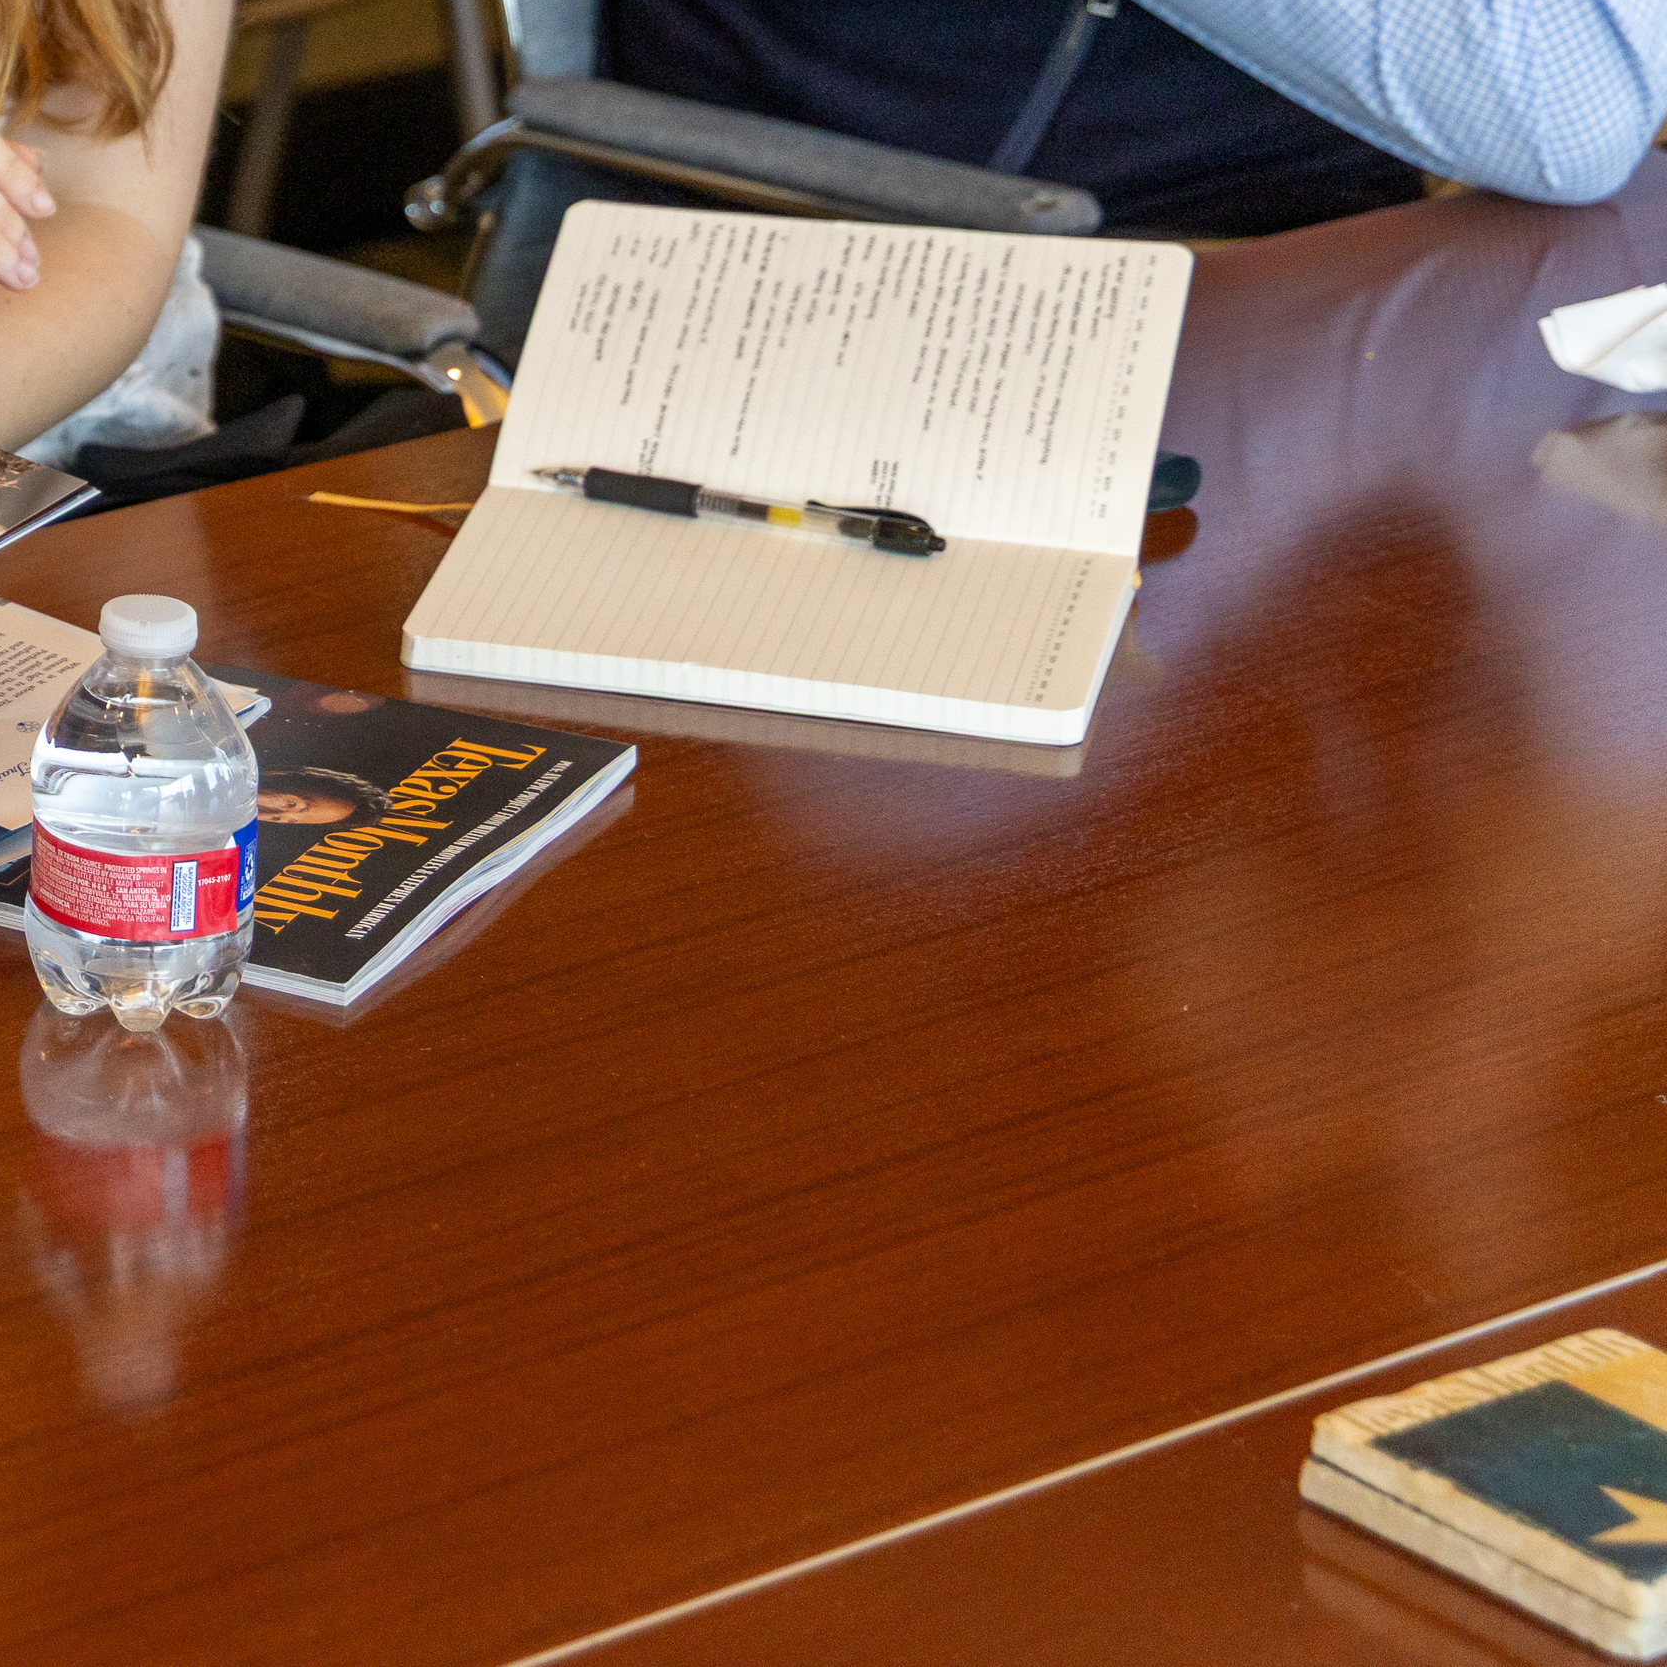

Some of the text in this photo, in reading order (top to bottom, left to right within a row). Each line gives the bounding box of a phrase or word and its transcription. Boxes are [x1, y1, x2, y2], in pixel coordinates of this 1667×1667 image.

[502, 791, 540, 814] PROJECT
[453, 824, 497, 847] WILLIAM
[104, 863, 136, 874] PROTECTED
[101, 870, 108, 878] BY
[109, 872, 141, 881] ADVANCED
[197, 873, 232, 887] 17045-2107
[115, 879, 134, 888] MADE
[384, 874, 428, 905] STEPHEN
[100, 904, 130, 915] CHOKING
[102, 912, 116, 921] UNA
[117, 914, 134, 922] PIEZA
[135, 914, 165, 922] PEQUEÑA
[345, 902, 396, 940] HARRIGAN
